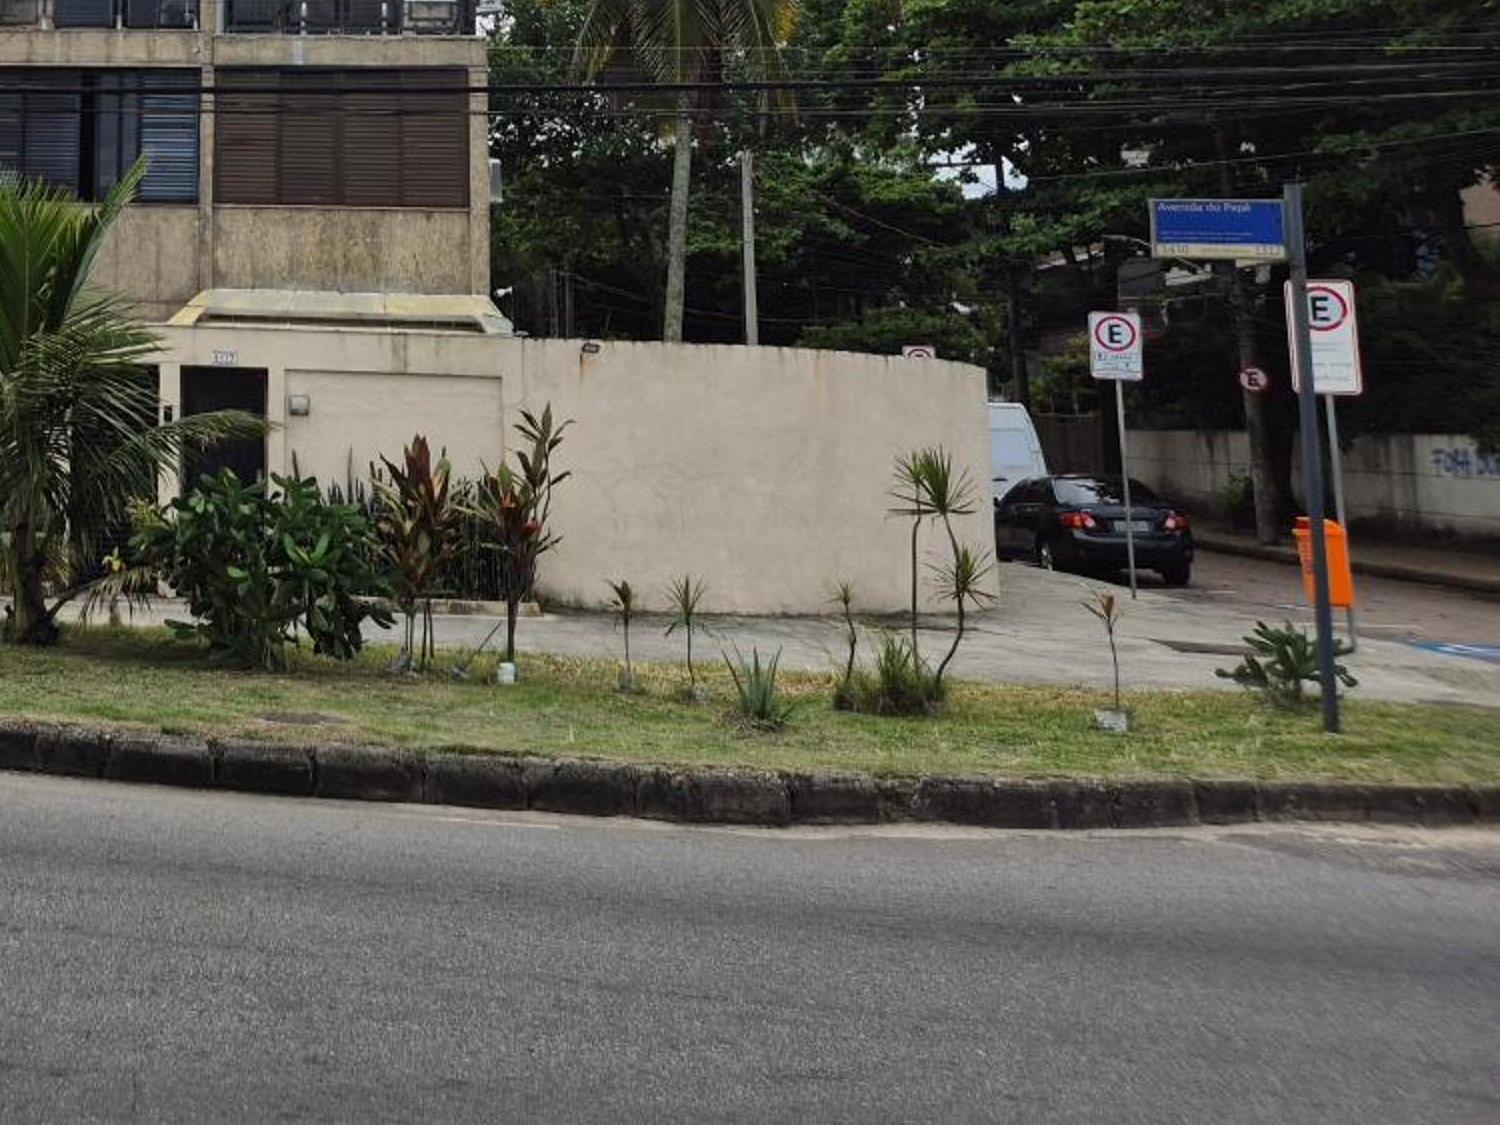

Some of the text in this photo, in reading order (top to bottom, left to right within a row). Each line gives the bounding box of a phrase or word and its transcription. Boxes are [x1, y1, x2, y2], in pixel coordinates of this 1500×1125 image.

[1157, 202, 1203, 213] Avenida
[1205, 202, 1221, 213] do
[1308, 296, 1332, 322] E
[1108, 324, 1123, 344] E
[1247, 371, 1260, 387] E
